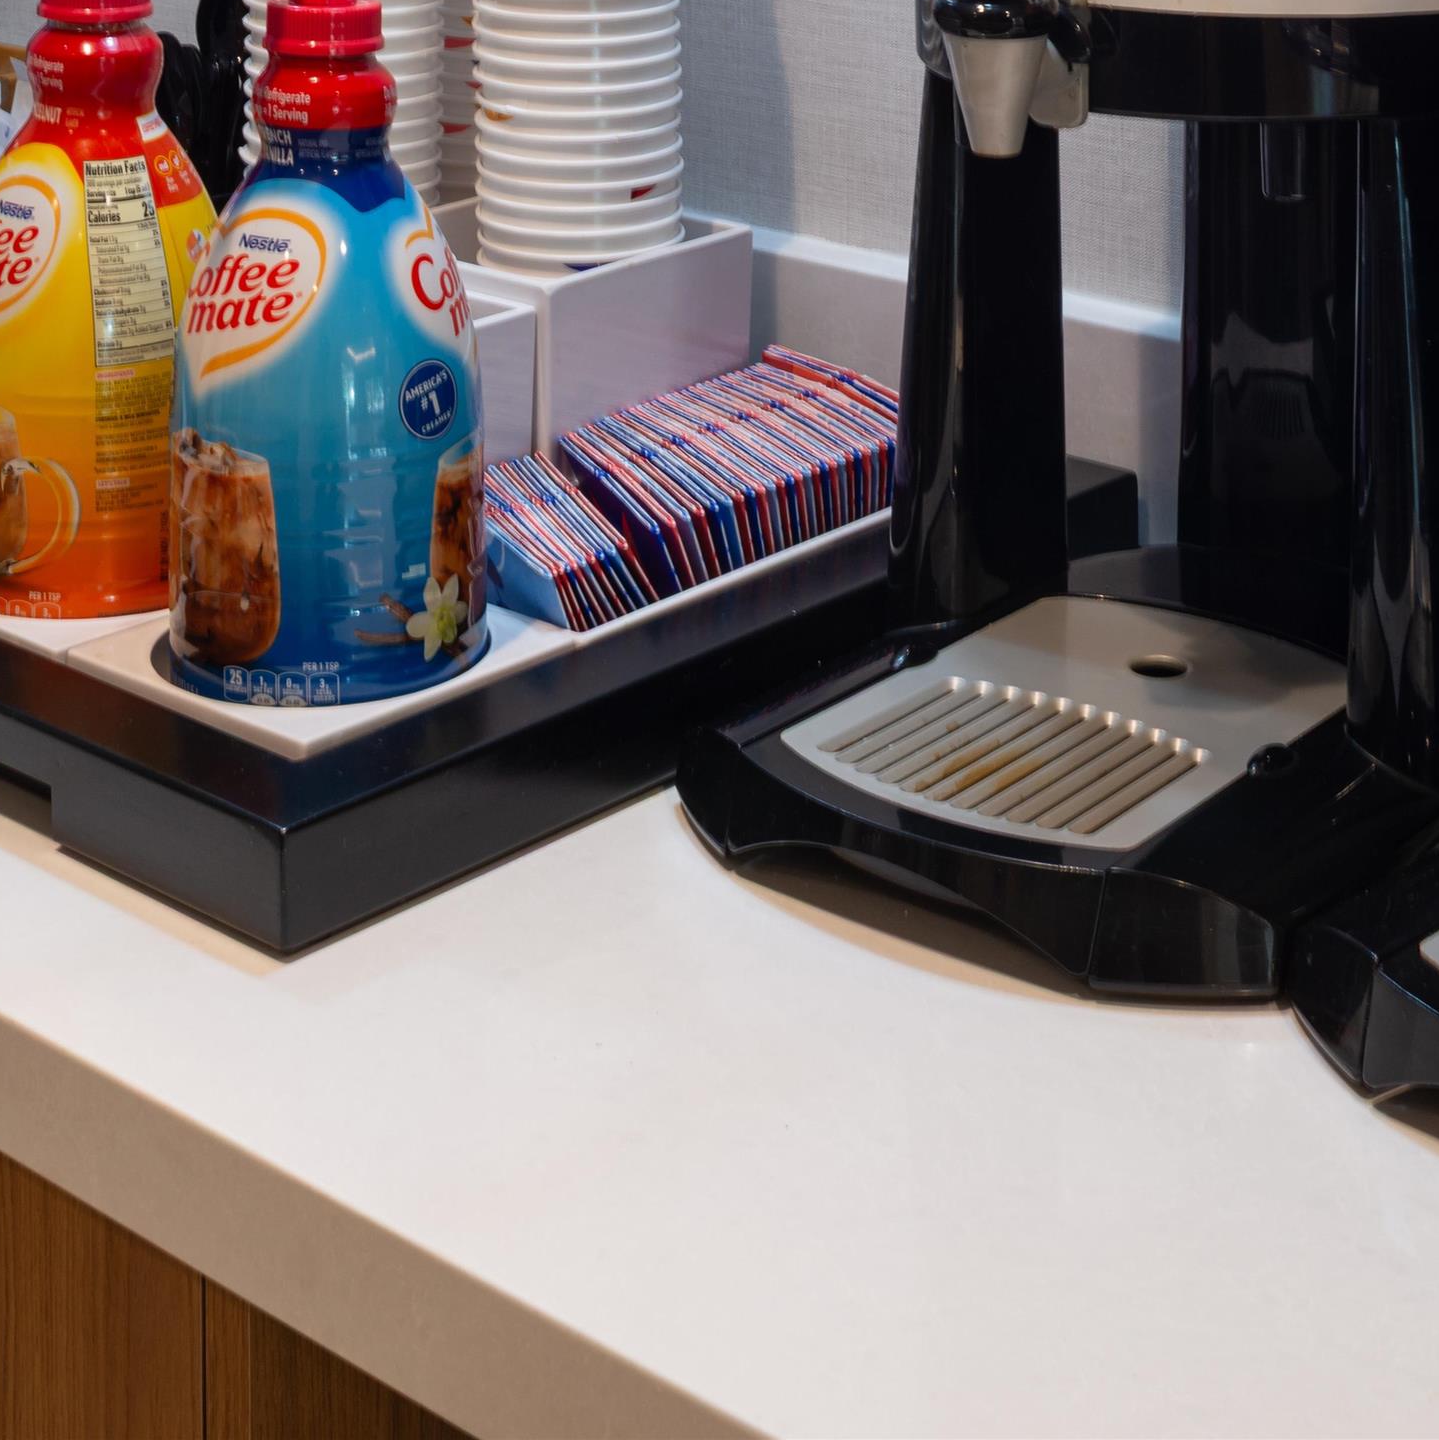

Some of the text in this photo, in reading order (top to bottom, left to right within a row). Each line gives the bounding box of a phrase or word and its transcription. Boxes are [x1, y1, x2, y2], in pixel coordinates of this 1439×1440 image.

[273, 106, 309, 126] Serving
[85, 159, 146, 176] Nutrition Facts
[88, 201, 155, 223] Calories 25
[187, 252, 300, 299] offee
[186, 290, 294, 335] mate
[405, 369, 449, 403] AMERICA'S
[229, 669, 243, 685] 25
[302, 661, 318, 672] PER
[325, 662, 340, 672] TSP
